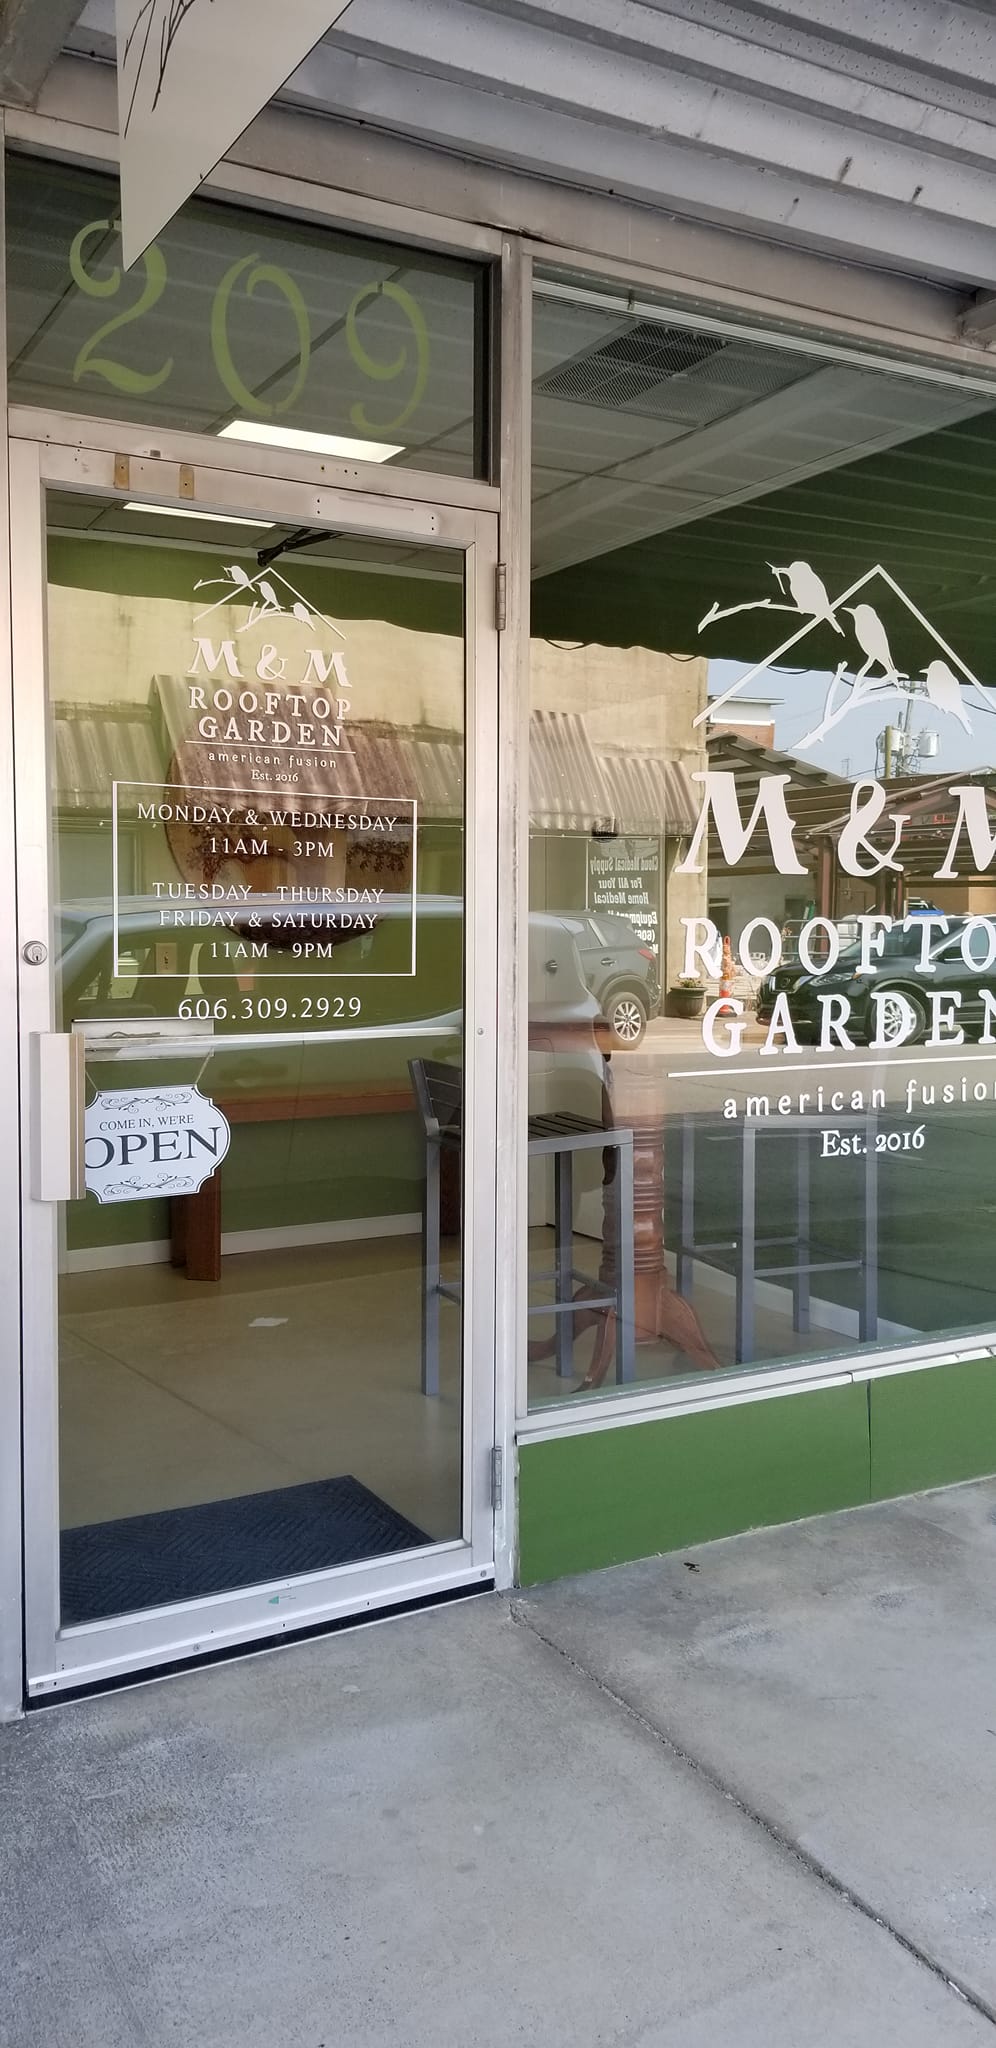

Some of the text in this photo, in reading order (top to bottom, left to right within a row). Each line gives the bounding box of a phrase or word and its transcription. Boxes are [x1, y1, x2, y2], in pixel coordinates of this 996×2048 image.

[70, 219, 430, 435] 209
[187, 637, 352, 687] M & M
[188, 686, 351, 720] ROOFTOP
[198, 716, 343, 747] GARDEN
[208, 752, 337, 769] american fusion
[251, 770, 299, 782] Est. 2016
[137, 803, 398, 832] MONDAY & WEDNESDAY
[674, 771, 809, 875] M
[838, 778, 911, 877] &
[209, 838, 269, 856] 11AM
[292, 841, 334, 857] 3PM
[152, 882, 252, 900] TUESDAY
[276, 886, 385, 903] THURSDAY
[159, 910, 379, 929] FRIDAY & SATURDAY
[210, 943, 269, 959] 11AM
[291, 942, 333, 959] 9PM
[178, 997, 362, 1020] 606.309.2929
[723, 1077, 996, 1119] american fusio
[99, 1119, 136, 1132] COME
[157, 1114, 195, 1126] WE'RE
[85, 1126, 222, 1169] OPEN
[819, 1123, 926, 1158] Est. 2016
